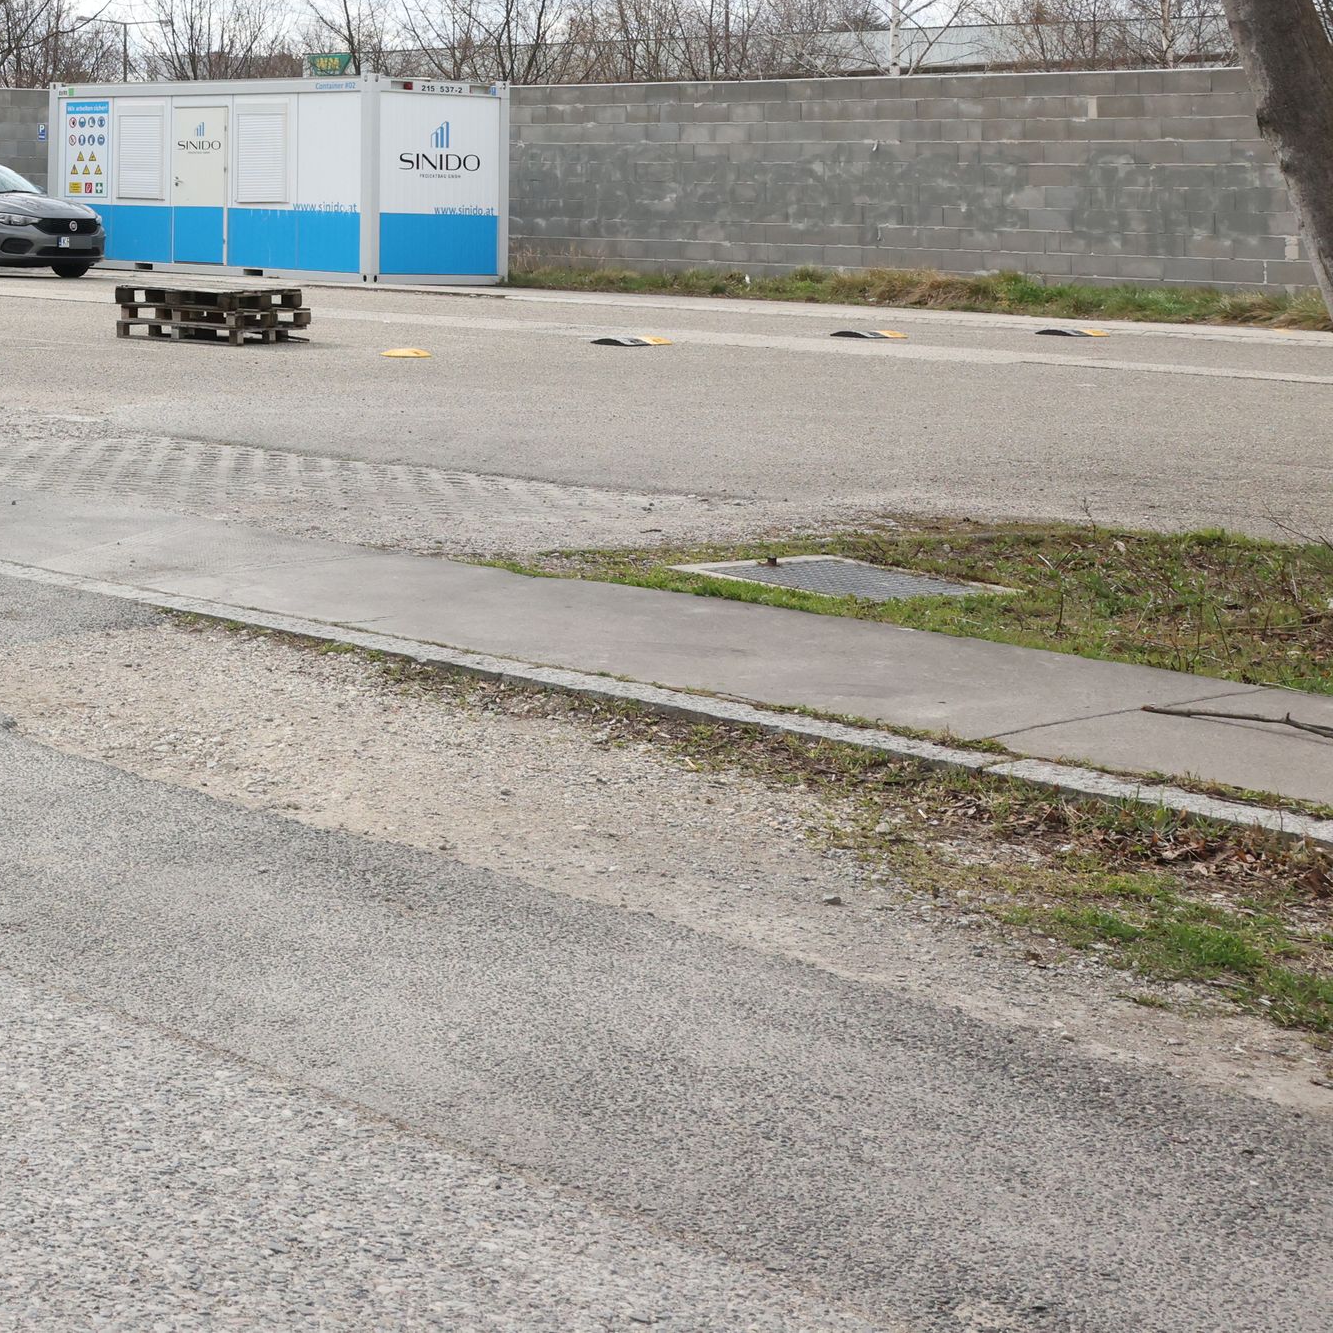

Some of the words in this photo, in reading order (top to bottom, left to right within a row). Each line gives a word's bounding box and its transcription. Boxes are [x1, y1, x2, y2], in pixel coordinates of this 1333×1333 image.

[316, 82, 343, 90] Container
[177, 140, 222, 150] SINIDO
[398, 152, 481, 172] SINIDO
[434, 205, 494, 216] www.sinido.at
